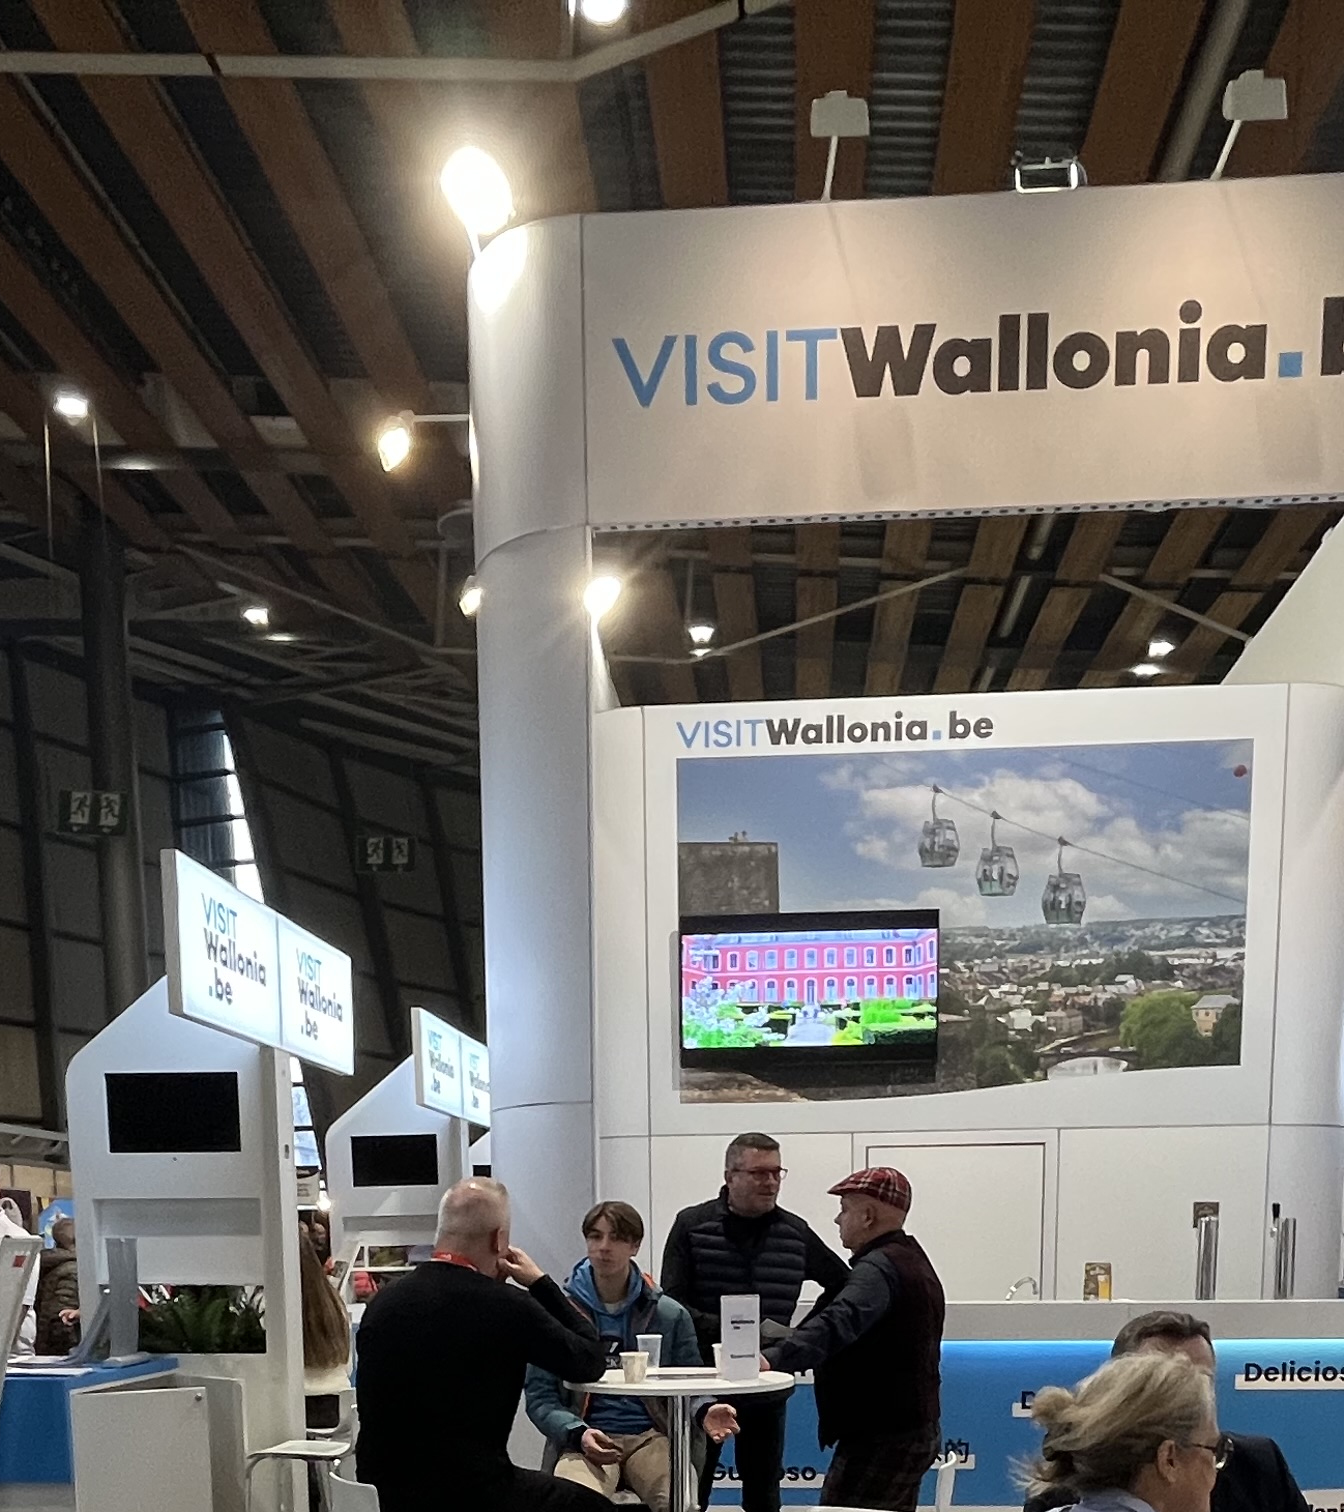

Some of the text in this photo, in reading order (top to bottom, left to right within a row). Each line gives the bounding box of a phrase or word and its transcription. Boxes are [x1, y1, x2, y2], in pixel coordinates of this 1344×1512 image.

[675, 711, 994, 749] VISITWallonia.be
[201, 893, 237, 939] VISIT
[203, 928, 266, 986] Wallonia
[296, 948, 322, 985] VISIT
[298, 977, 343, 1022] Wallonia
